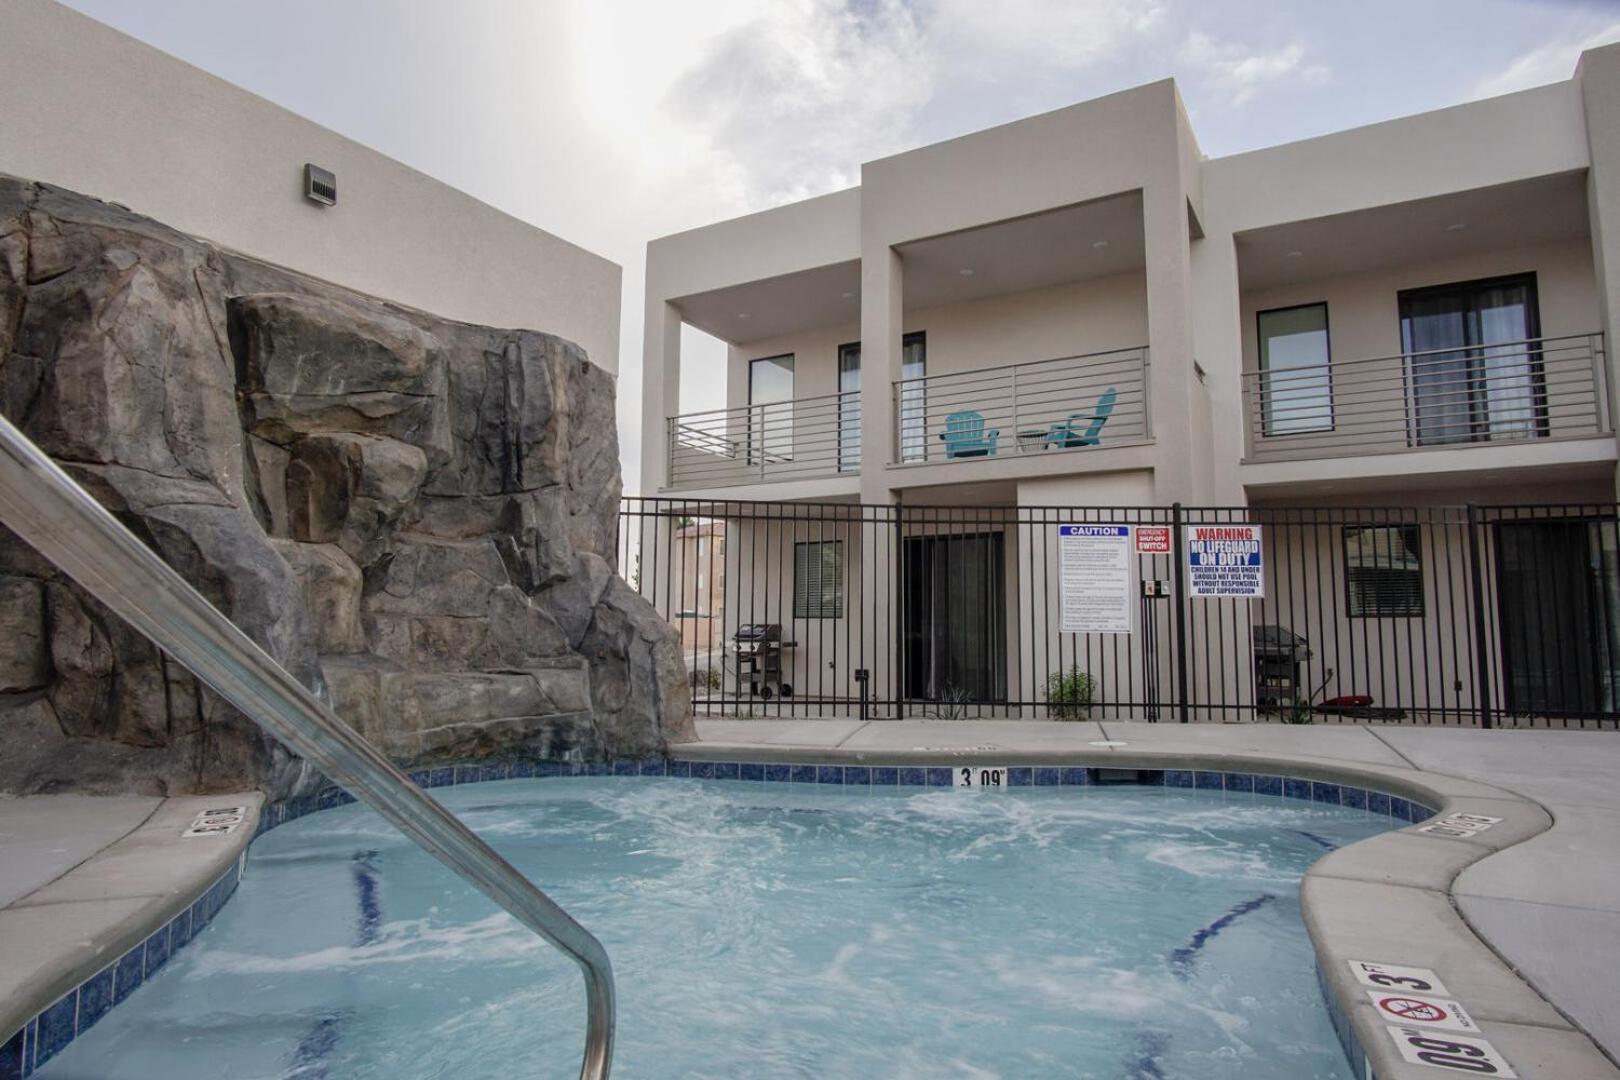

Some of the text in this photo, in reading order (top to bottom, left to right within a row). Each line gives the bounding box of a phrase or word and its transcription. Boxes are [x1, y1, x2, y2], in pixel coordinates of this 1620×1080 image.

[1070, 527, 1119, 536] CAUTION
[1196, 528, 1253, 540] WARNING
[1138, 542, 1167, 550] SWITCH
[1191, 541, 1258, 553] NO LIFEGUARD
[1199, 553, 1250, 565] ON DUTY
